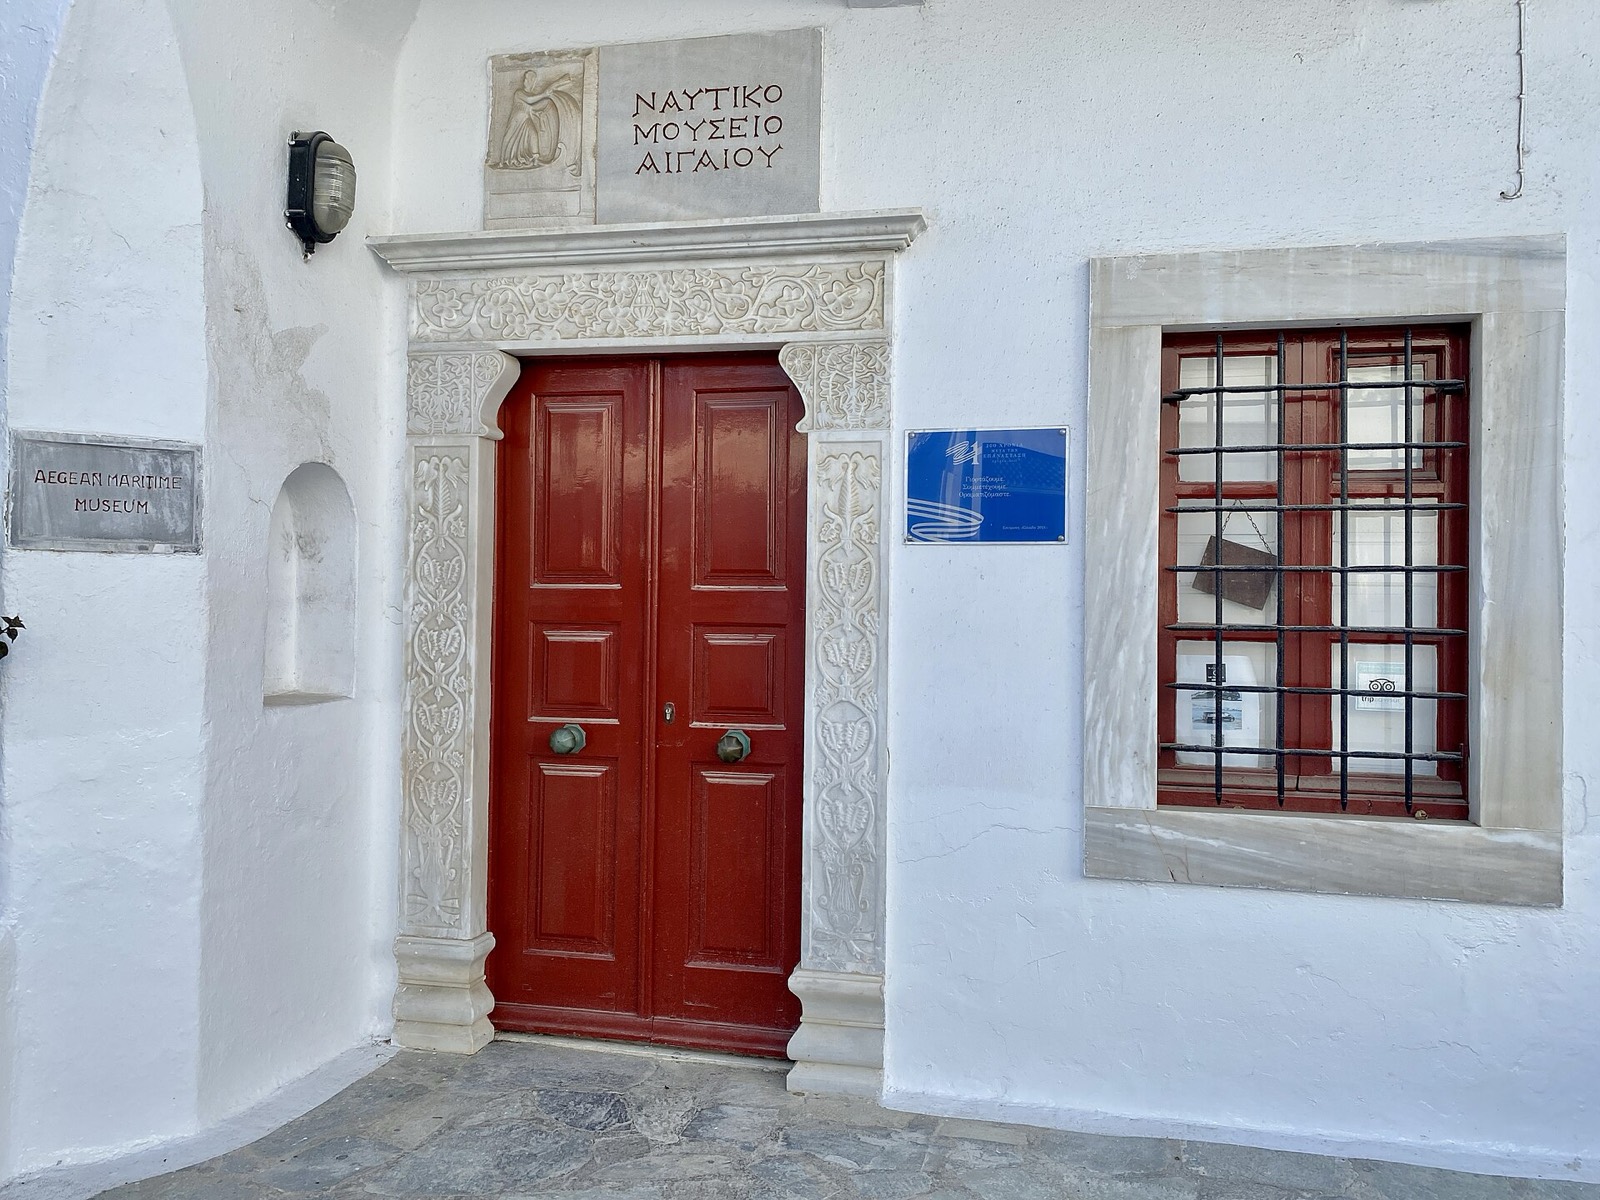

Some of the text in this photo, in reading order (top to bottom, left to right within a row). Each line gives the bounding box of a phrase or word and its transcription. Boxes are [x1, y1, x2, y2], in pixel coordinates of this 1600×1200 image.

[632, 85, 783, 117] ΝΑΥΤΙΚΟ
[633, 115, 783, 145] ΜΟΥΣΕΙΟ
[635, 144, 783, 174] ΑΙΓΑΙΟΥ
[34, 470, 182, 490] AEGEAN MARITIME
[74, 498, 149, 515] MUSEUM
